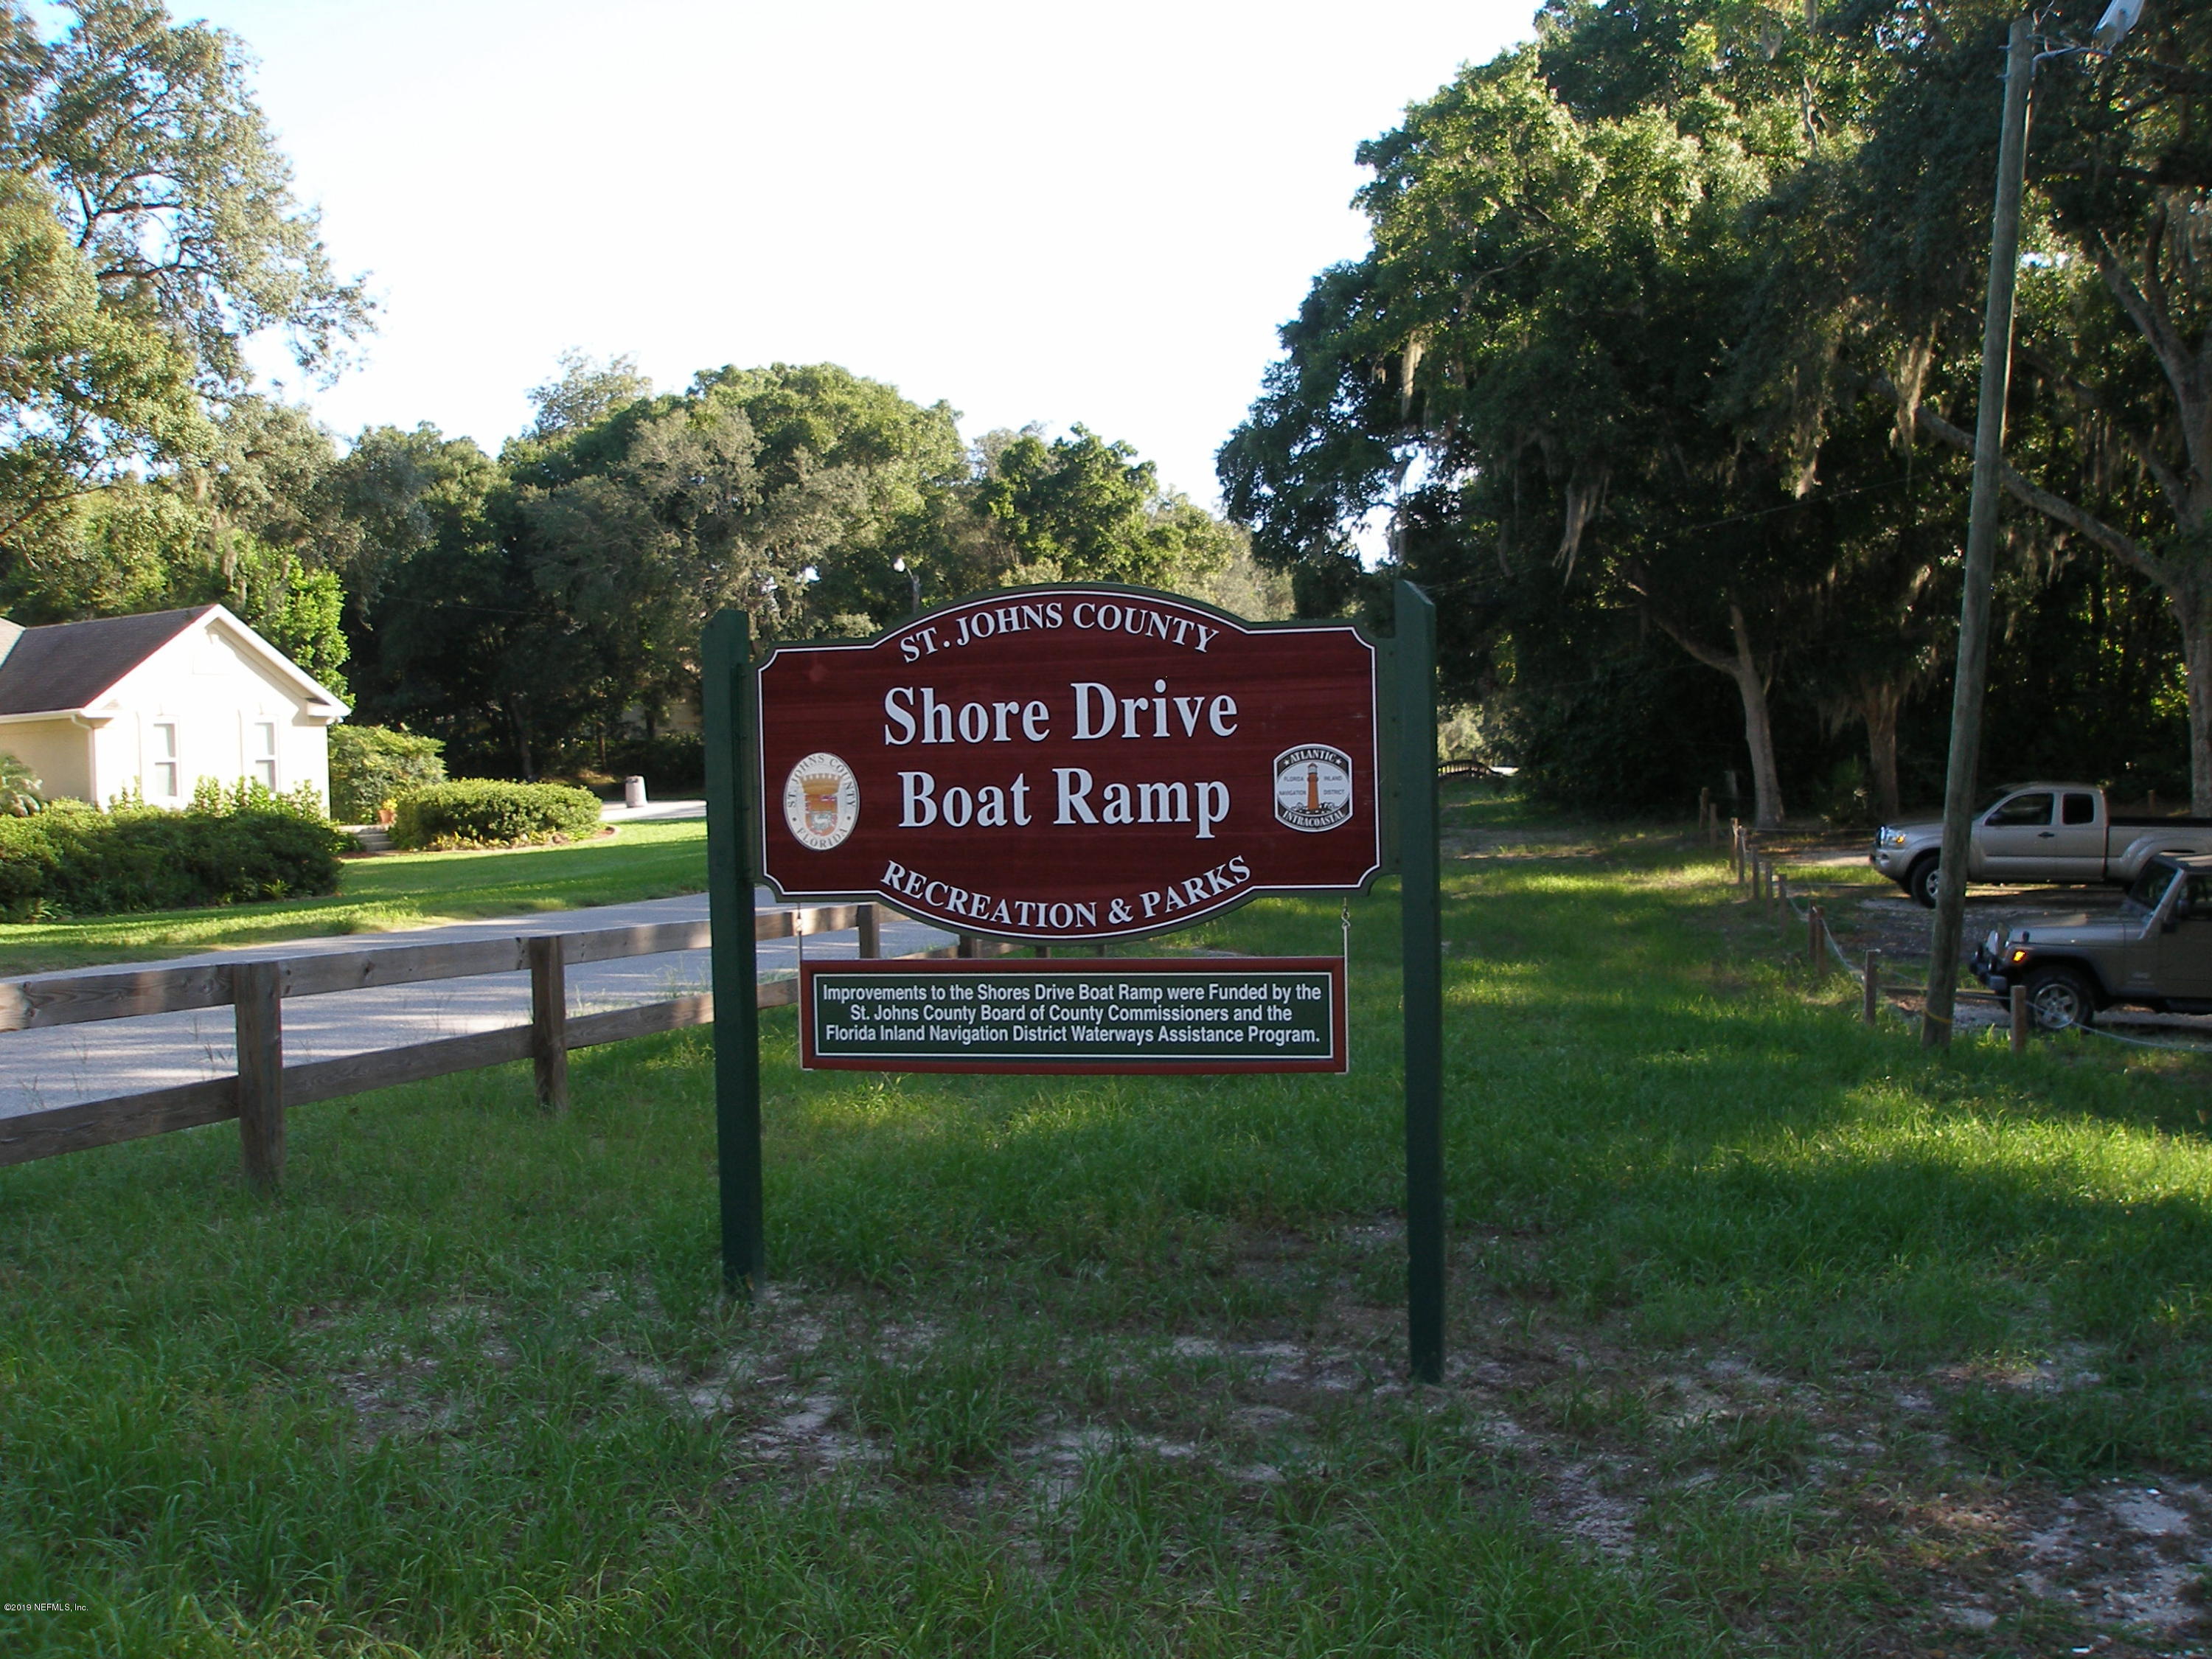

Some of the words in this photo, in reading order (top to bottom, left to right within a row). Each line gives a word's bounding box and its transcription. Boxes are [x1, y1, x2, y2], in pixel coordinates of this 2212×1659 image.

[900, 627, 951, 663] ST.
[956, 602, 1063, 647] JOHNS
[1072, 602, 1219, 653] COUNTY
[885, 686, 1050, 745] Shore
[1070, 679, 1238, 740] Drive
[1290, 749, 1336, 763] ATLANTIC
[791, 754, 825, 784] JOHNS
[830, 758, 856, 807] COUNTY
[787, 790, 796, 808] ST.
[897, 771, 1032, 827] Boat
[1051, 768, 1230, 838] Ramp
[1283, 810, 1344, 827] INTRACOASTAL
[797, 827, 847, 848] FLORIDA
[880, 860, 1097, 928] RECREATION
[1108, 898, 1134, 924] &
[1139, 856, 1251, 919] PARKS
[823, 984, 928, 1004] Improvements
[931, 984, 946, 1001] to
[949, 984, 974, 1001] the
[977, 983, 1031, 1001] Shores
[1034, 984, 1075, 1001] Drive
[1079, 984, 1114, 1001] Boat
[1119, 984, 1164, 1004] Ramp
[1166, 987, 1205, 1001] were
[1208, 983, 1267, 1000] Funded
[1272, 983, 1292, 1004] by
[1295, 983, 1321, 1000] the
[850, 1004, 870, 1020] St.
[874, 1004, 919, 1021] Johns
[923, 1004, 977, 1025] County
[981, 1004, 1026, 1021] Board
[1029, 1004, 1046, 1021] of
[1048, 1004, 1102, 1025] County
[1107, 1004, 1229, 1021] Commissioners
[1233, 1004, 1262, 1021] and
[1267, 1004, 1293, 1021] the
[826, 1024, 877, 1041] Florida
[880, 1024, 925, 1041] Inland
[929, 1024, 1009, 1046] Navigation
[1012, 1025, 1068, 1042] District
[1071, 1025, 1154, 1046] Waterways
[1158, 1025, 1244, 1043] Assistance
[1248, 1025, 1320, 1047] Program.
